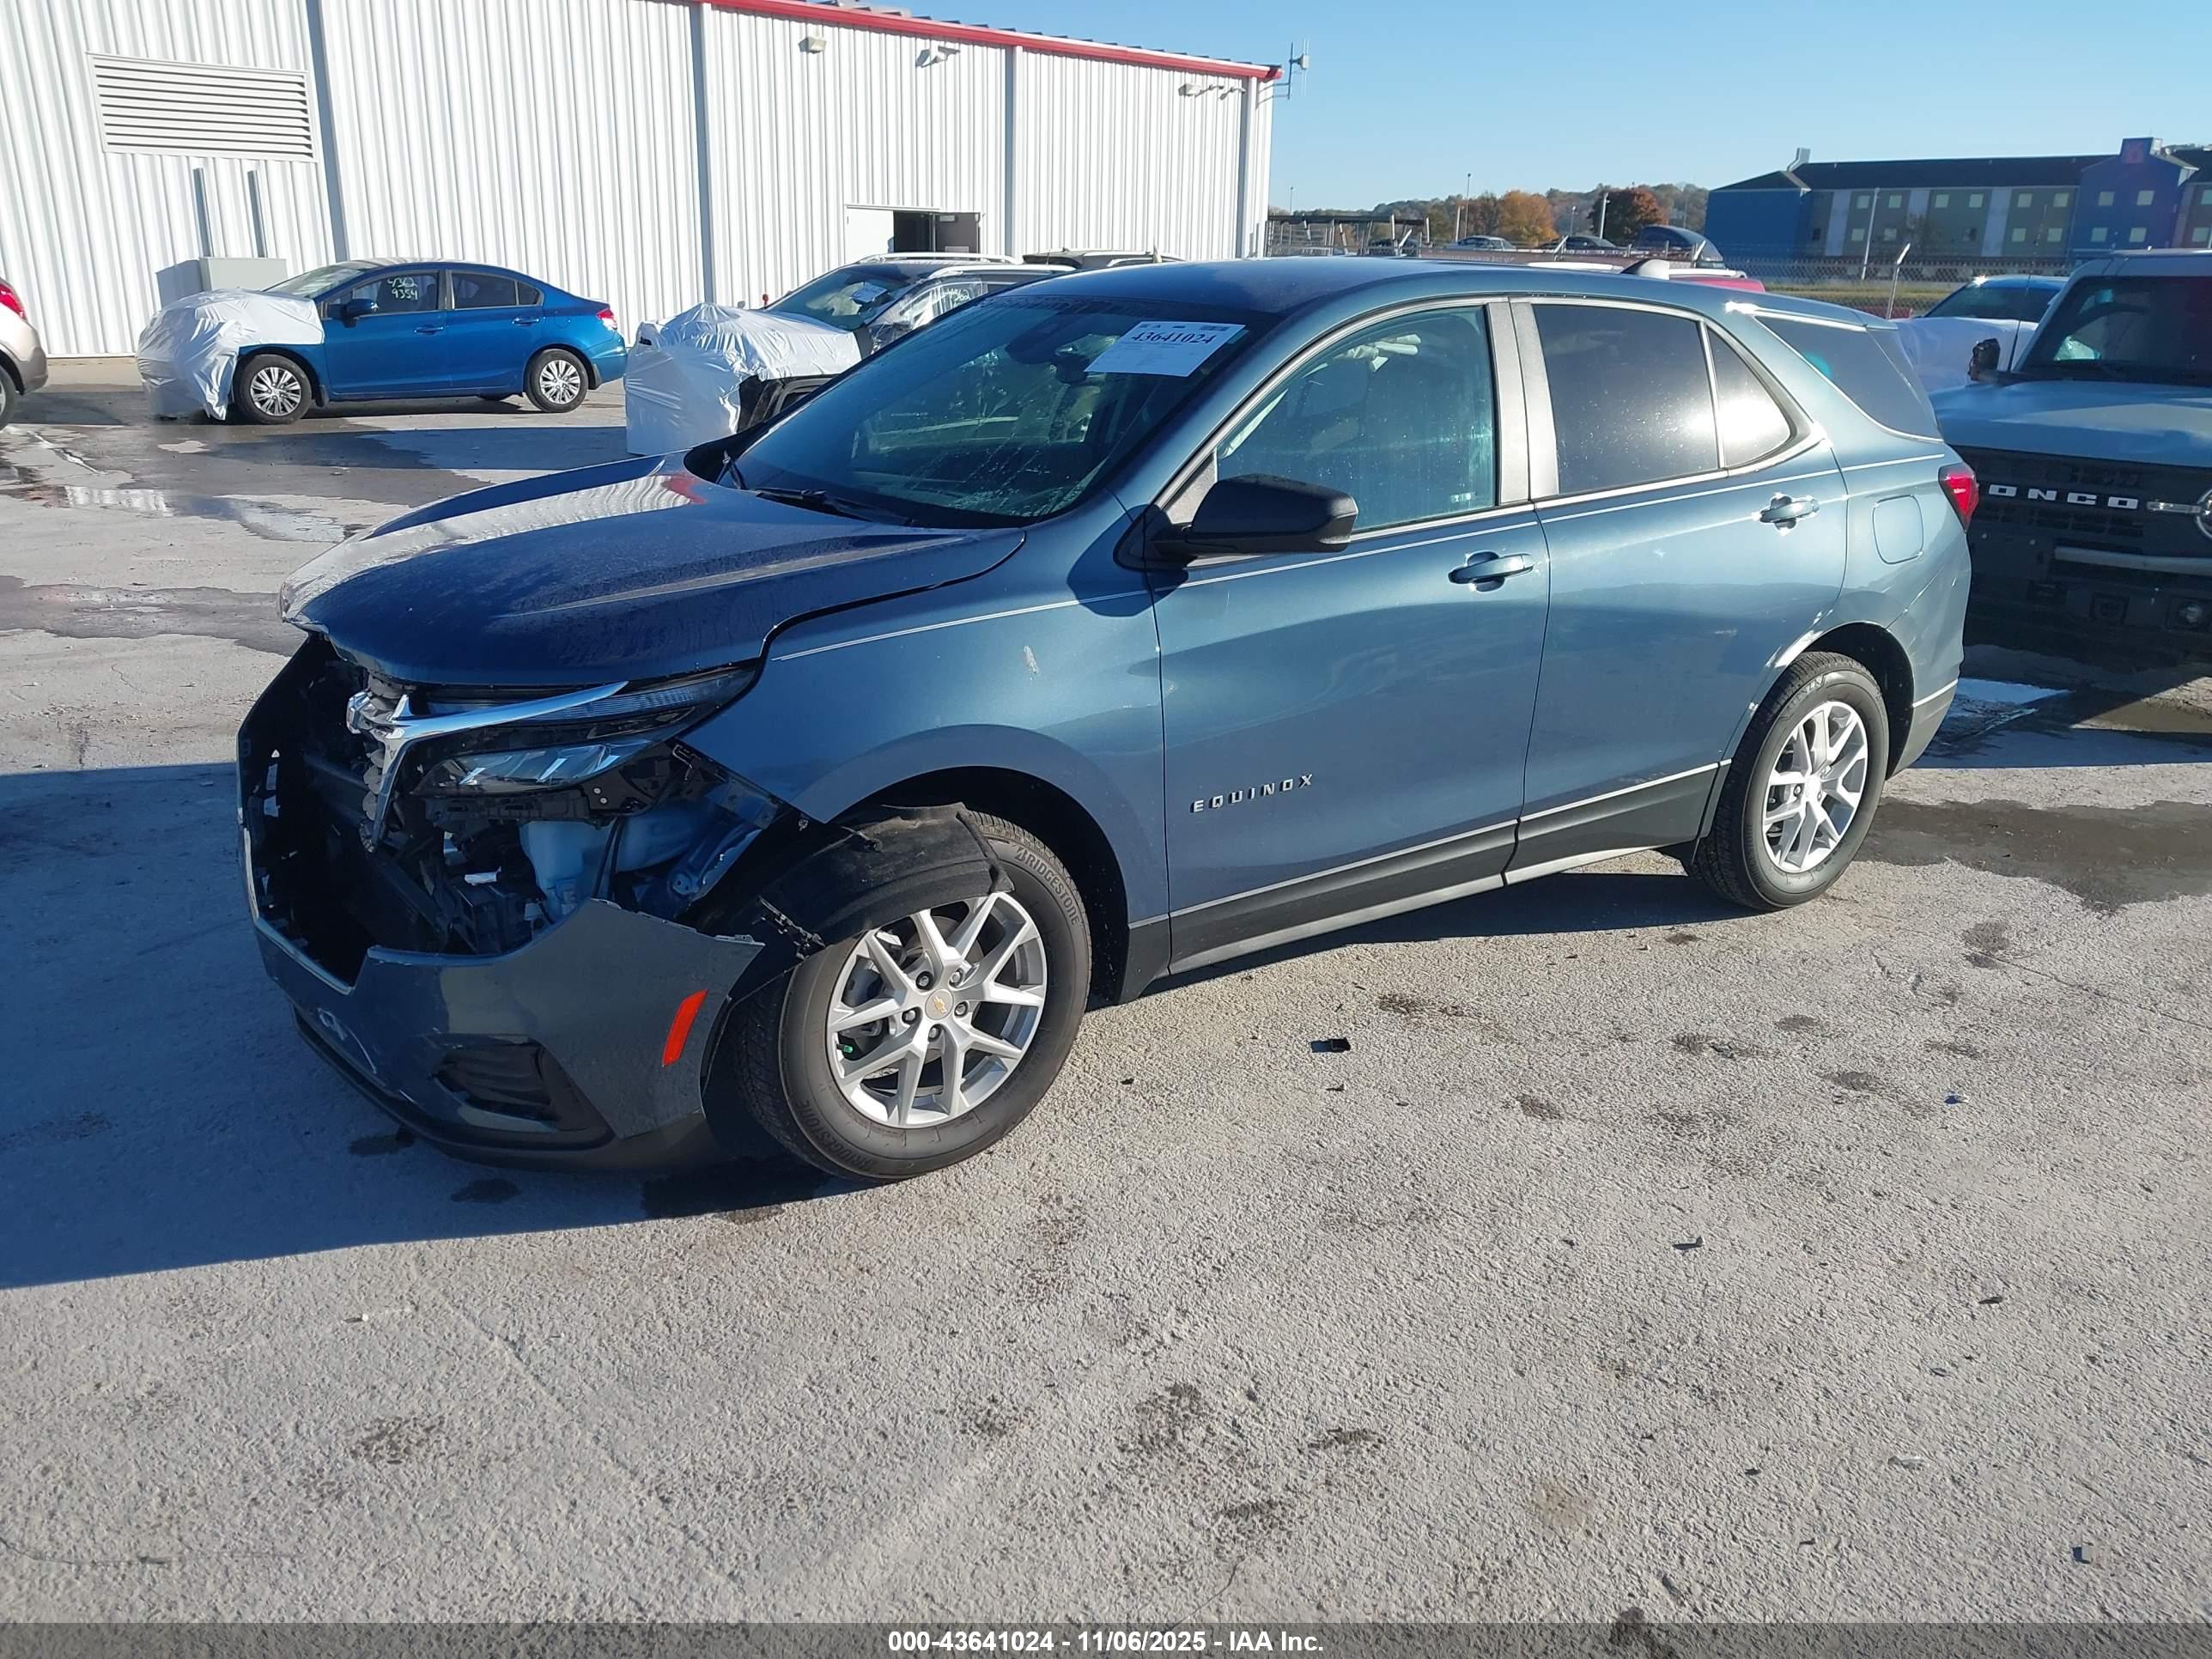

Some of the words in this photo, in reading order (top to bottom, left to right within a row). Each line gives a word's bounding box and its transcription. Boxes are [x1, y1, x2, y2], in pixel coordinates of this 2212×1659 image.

[1132, 331, 1217, 344] 43641024
[1989, 484, 2139, 509] ONCO
[1191, 774, 1313, 812] EQUINOX
[1015, 846, 1080, 926] BRIDGESTONE
